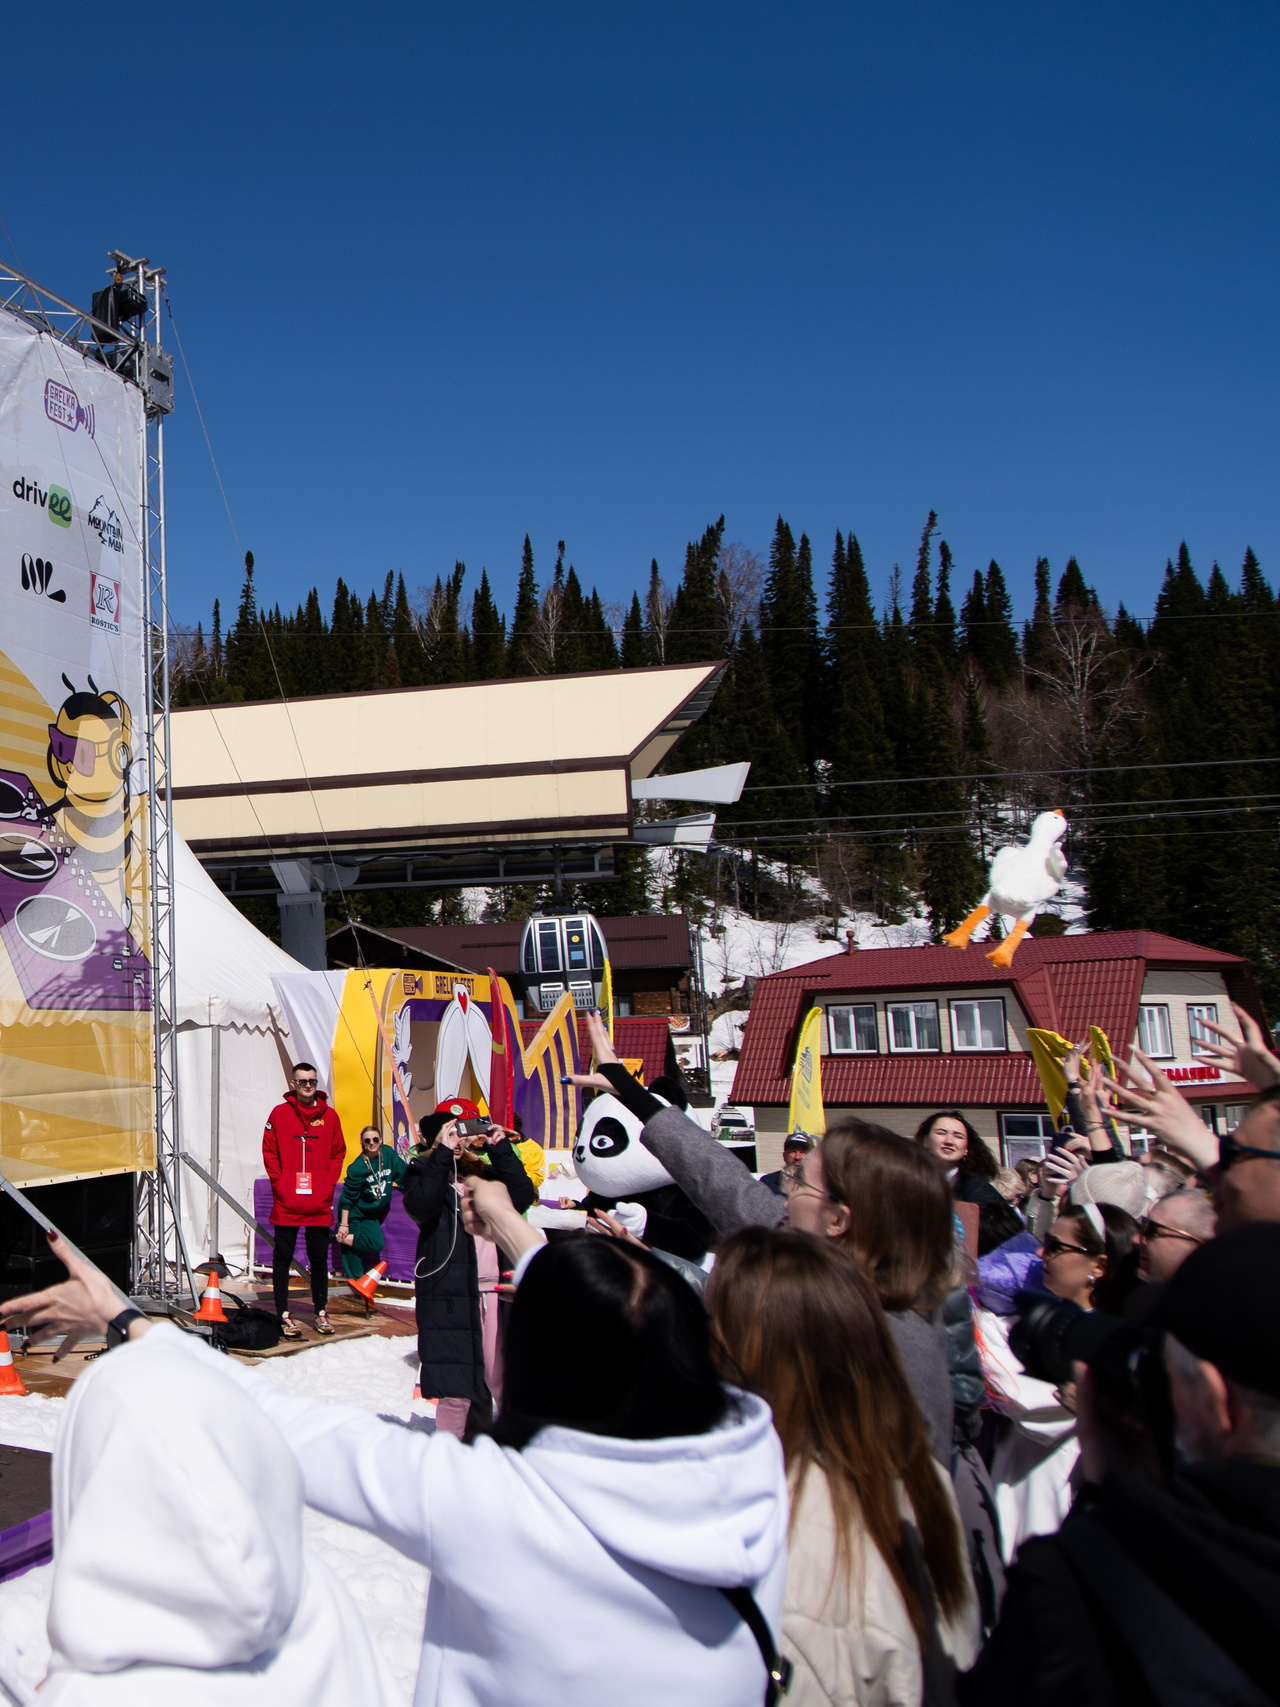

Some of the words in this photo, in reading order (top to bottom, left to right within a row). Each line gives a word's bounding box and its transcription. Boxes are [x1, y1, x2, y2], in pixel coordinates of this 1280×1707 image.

[50, 385, 75, 410] GRELKA
[50, 401, 66, 420] FEST
[13, 476, 72, 522] drivee
[108, 536, 124, 554] MAN
[91, 616, 119, 632] ROSTIC'S
